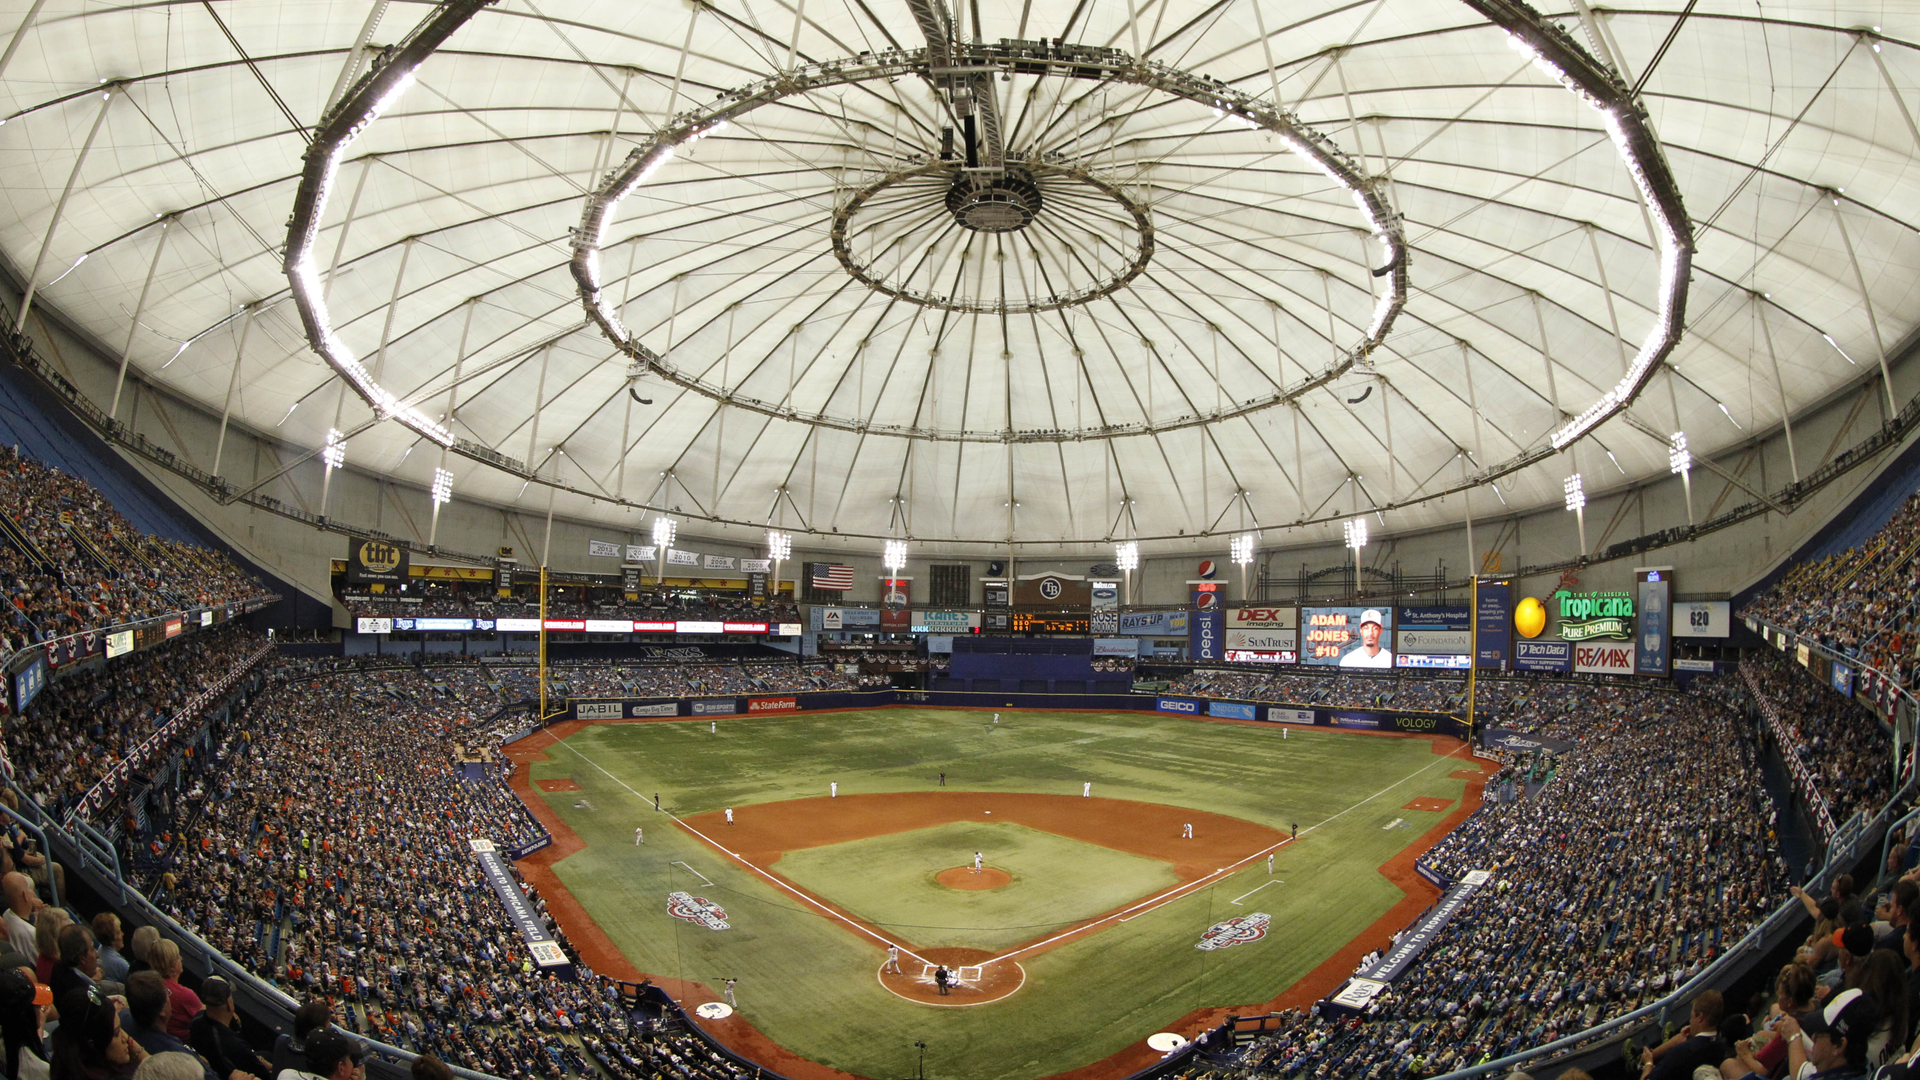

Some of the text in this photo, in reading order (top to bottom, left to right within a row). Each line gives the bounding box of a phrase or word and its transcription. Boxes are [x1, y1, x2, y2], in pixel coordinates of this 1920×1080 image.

[366, 543, 395, 564] tbt
[1044, 582, 1058, 595] TB
[1555, 590, 1633, 620] Tropicana
[924, 612, 969, 620] KANES
[1092, 613, 1117, 622] ROSE
[1122, 616, 1147, 628] RAYS
[1150, 614, 1163, 625] UP
[1236, 609, 1280, 621] DEX
[1309, 614, 1347, 626] ADAM
[1690, 611, 1709, 626] 620
[1170, 618, 1185, 628] YOU
[1306, 630, 1350, 642] JONES
[1562, 622, 1622, 638] PURE PREMIUM
[1200, 618, 1214, 659] pepsi
[1248, 637, 1294, 648] SUNTRUST
[1418, 636, 1466, 644] FOUNDATION
[640, 646, 704, 659] RAYS
[1095, 646, 1137, 654] Budweiser
[1315, 646, 1339, 657] #10
[1529, 645, 1566, 655] Tech Data
[1577, 647, 1630, 668] RE/MAX
[578, 704, 621, 713] JABIL
[1160, 700, 1195, 712] GEICO
[1211, 702, 1240, 713] Sagicor
[1396, 718, 1437, 728] VOLOGY
[483, 852, 543, 941] WELCOME TO TROPICANA FIELD
[670, 892, 706, 912] OPENING
[697, 910, 730, 930] SERIES
[1195, 913, 1271, 951] OPENING SERIES
[1371, 884, 1473, 980] WELCOME TO TROPICANA FIELD
[1340, 982, 1374, 1003] RAYS
